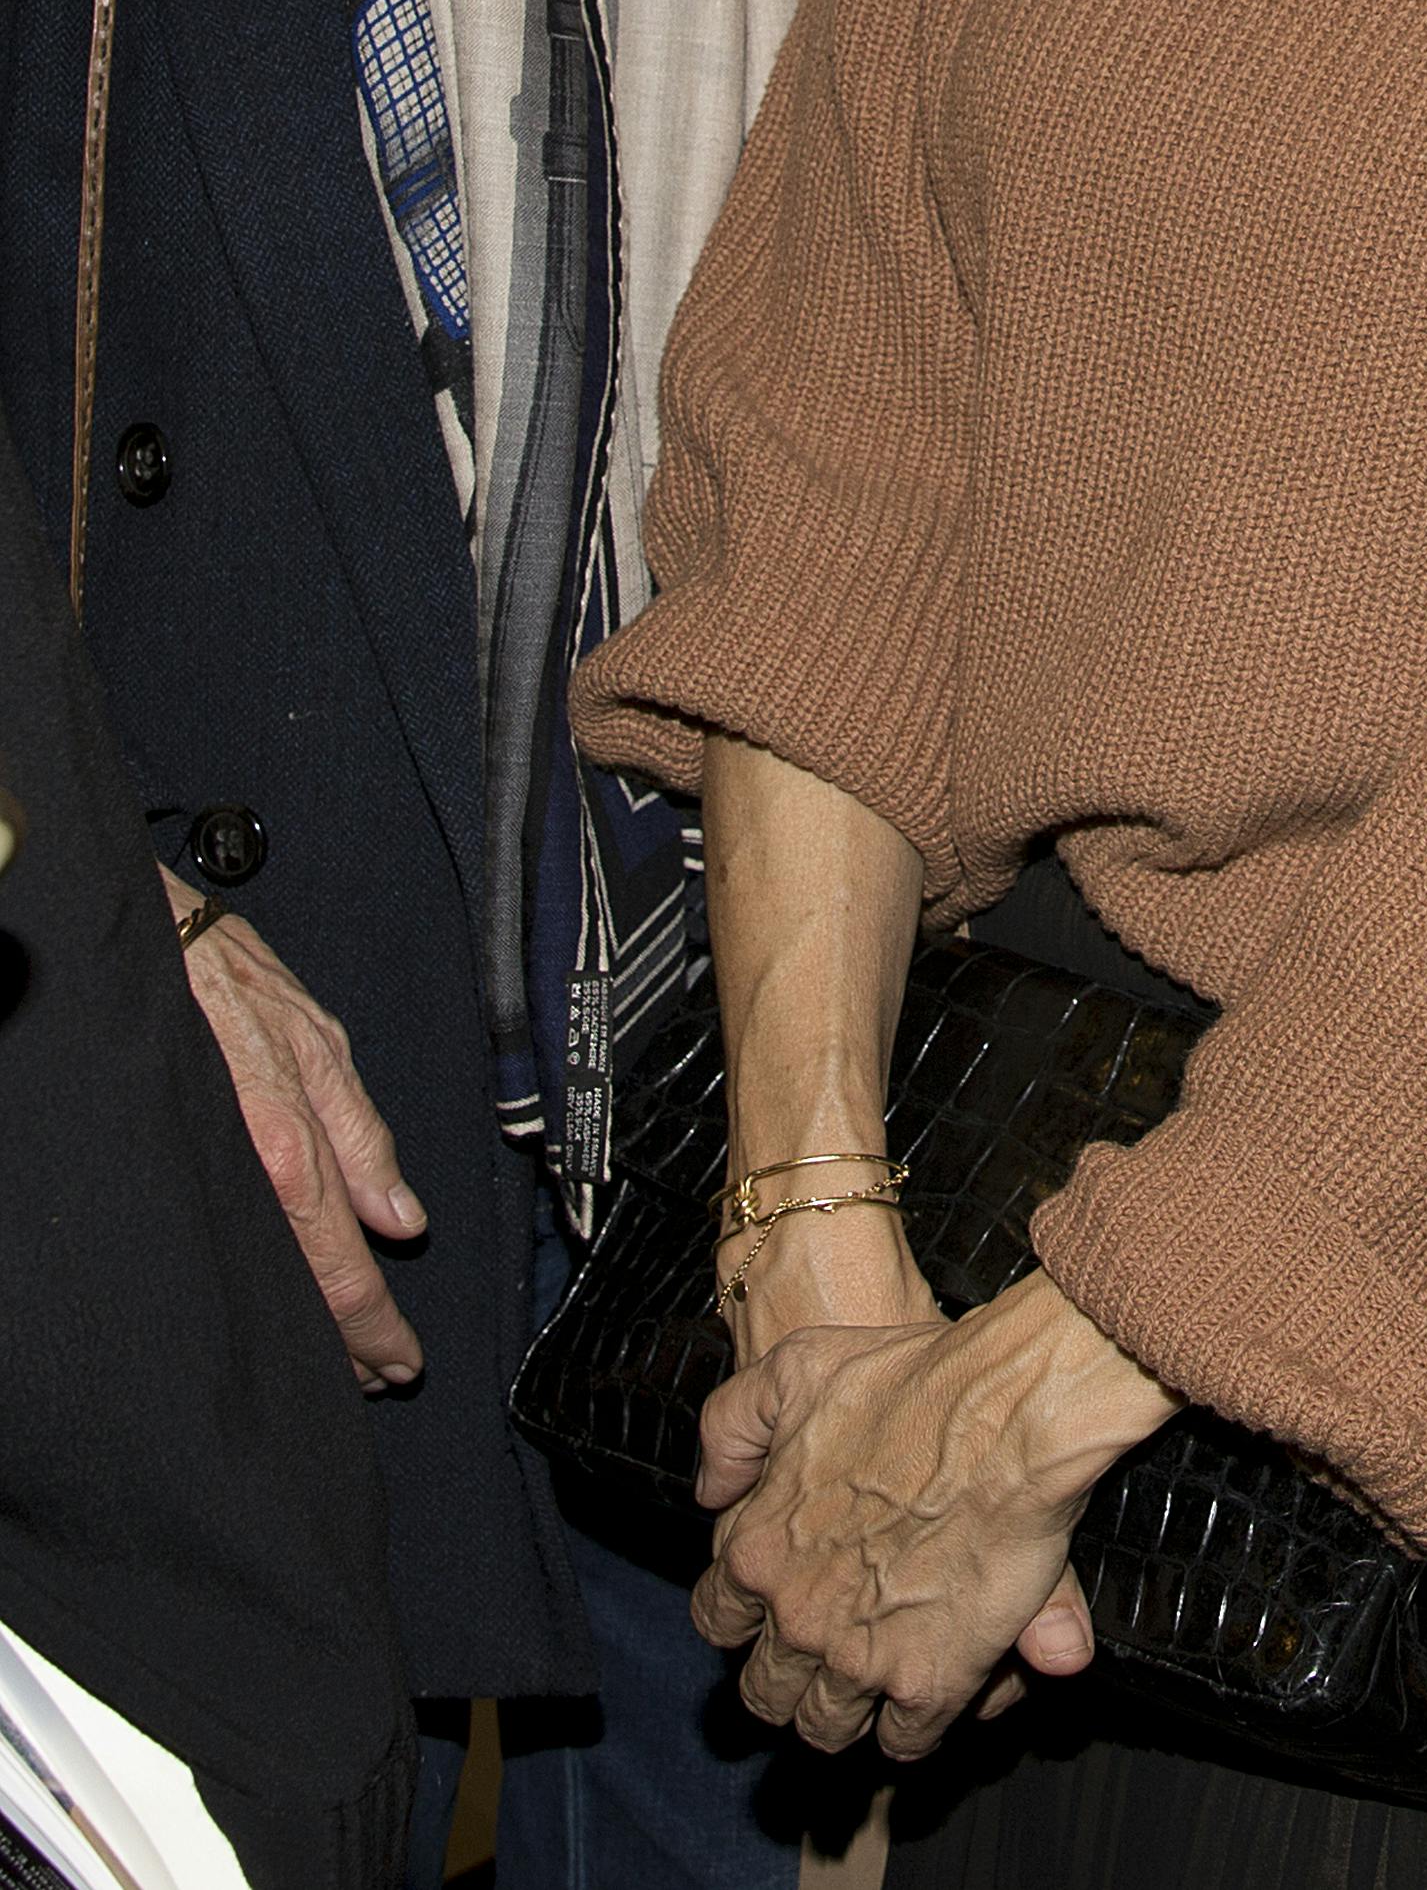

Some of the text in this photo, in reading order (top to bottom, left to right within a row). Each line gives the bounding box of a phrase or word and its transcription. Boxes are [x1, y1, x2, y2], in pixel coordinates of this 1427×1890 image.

[567, 1086, 575, 1108] DRY
[593, 1087, 602, 1119] MADE
[592, 1123, 600, 1135] IN
